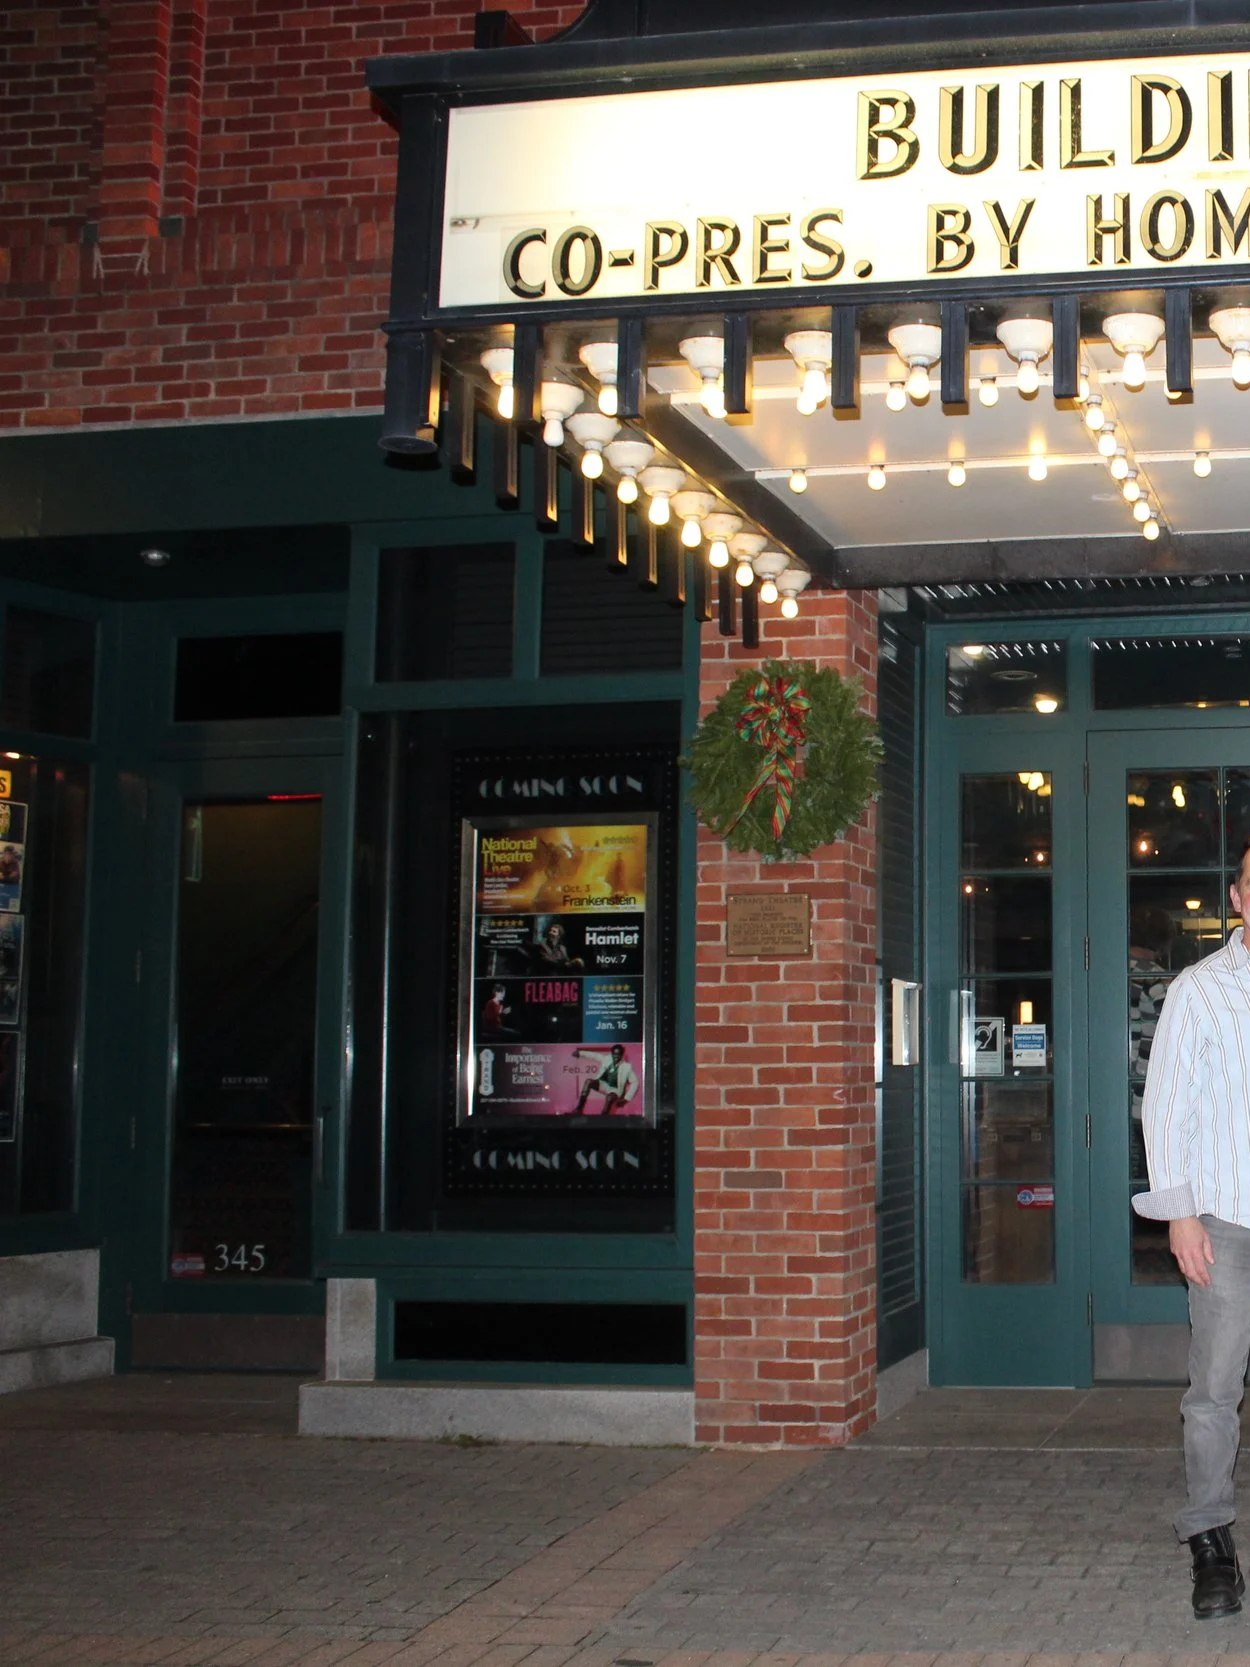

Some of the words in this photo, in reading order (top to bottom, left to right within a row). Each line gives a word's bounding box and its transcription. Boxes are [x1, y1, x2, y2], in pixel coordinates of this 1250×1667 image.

[503, 208, 874, 299] CO-PRES.
[927, 198, 1035, 274] BY
[481, 836, 538, 851] National
[482, 850, 533, 864] Theatre
[484, 862, 512, 876] Live
[562, 893, 637, 908] Frankenstein
[585, 932, 640, 946] Hamlet
[596, 955, 618, 964] Nov.
[620, 955, 627, 964] 7
[525, 982, 578, 1003] FLEABAG
[596, 1021, 614, 1030] Jan.
[617, 1021, 627, 1030] 16
[563, 1065, 581, 1074] Feb.
[585, 1065, 598, 1074] 20
[214, 1243, 265, 1271] 345
